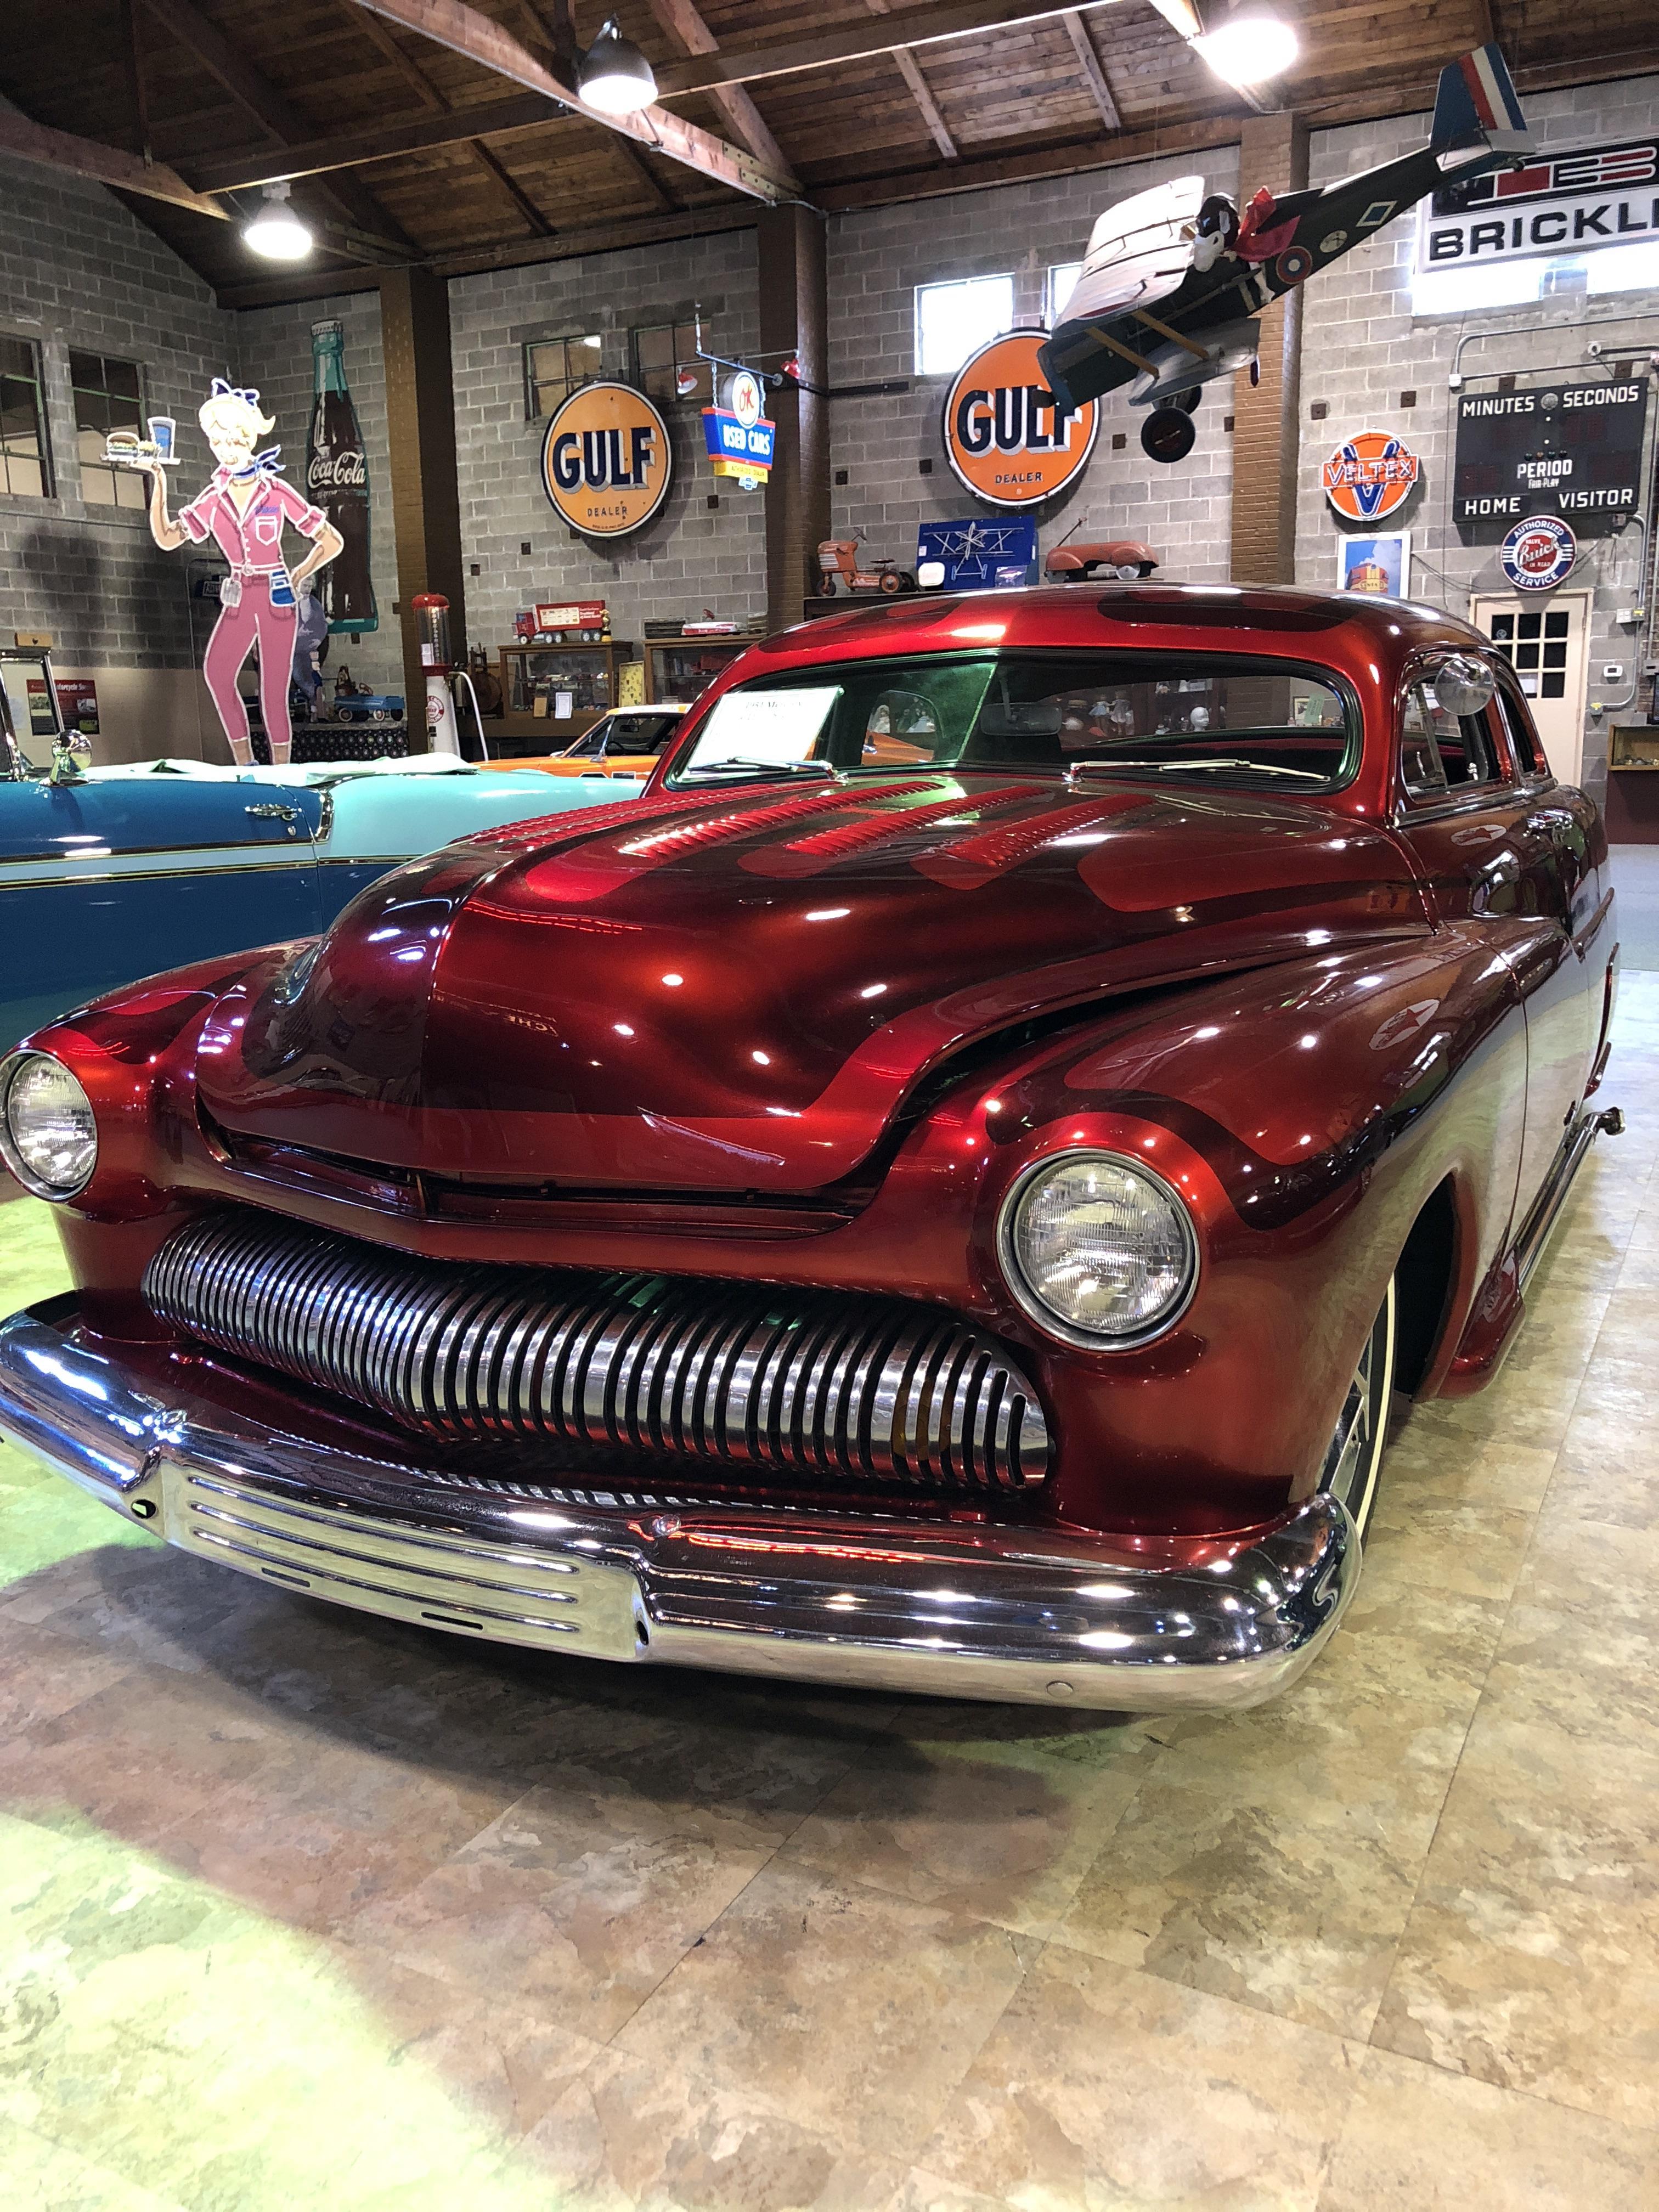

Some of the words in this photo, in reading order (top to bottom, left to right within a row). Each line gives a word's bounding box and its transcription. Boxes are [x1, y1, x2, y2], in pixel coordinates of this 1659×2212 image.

[740, 383, 754, 411] OK
[1463, 396, 1534, 417] MINUTES
[1563, 386, 1639, 408] SECONDS
[723, 424, 746, 451] USED
[748, 430, 770, 455] CARS
[308, 452, 366, 489] Coca-Cola
[552, 426, 656, 494] GULF
[1328, 459, 1414, 485] VELTEX
[1517, 459, 1573, 479] PERIOD
[995, 472, 1042, 484] DEALER
[588, 506, 628, 517] DEALER
[1465, 497, 1521, 515] HOME
[1559, 488, 1633, 509] VISITOR
[1514, 521, 1564, 539] AUTHORIZED
[1517, 536, 1561, 568] Buick
[1513, 572, 1559, 586] SERVICE
